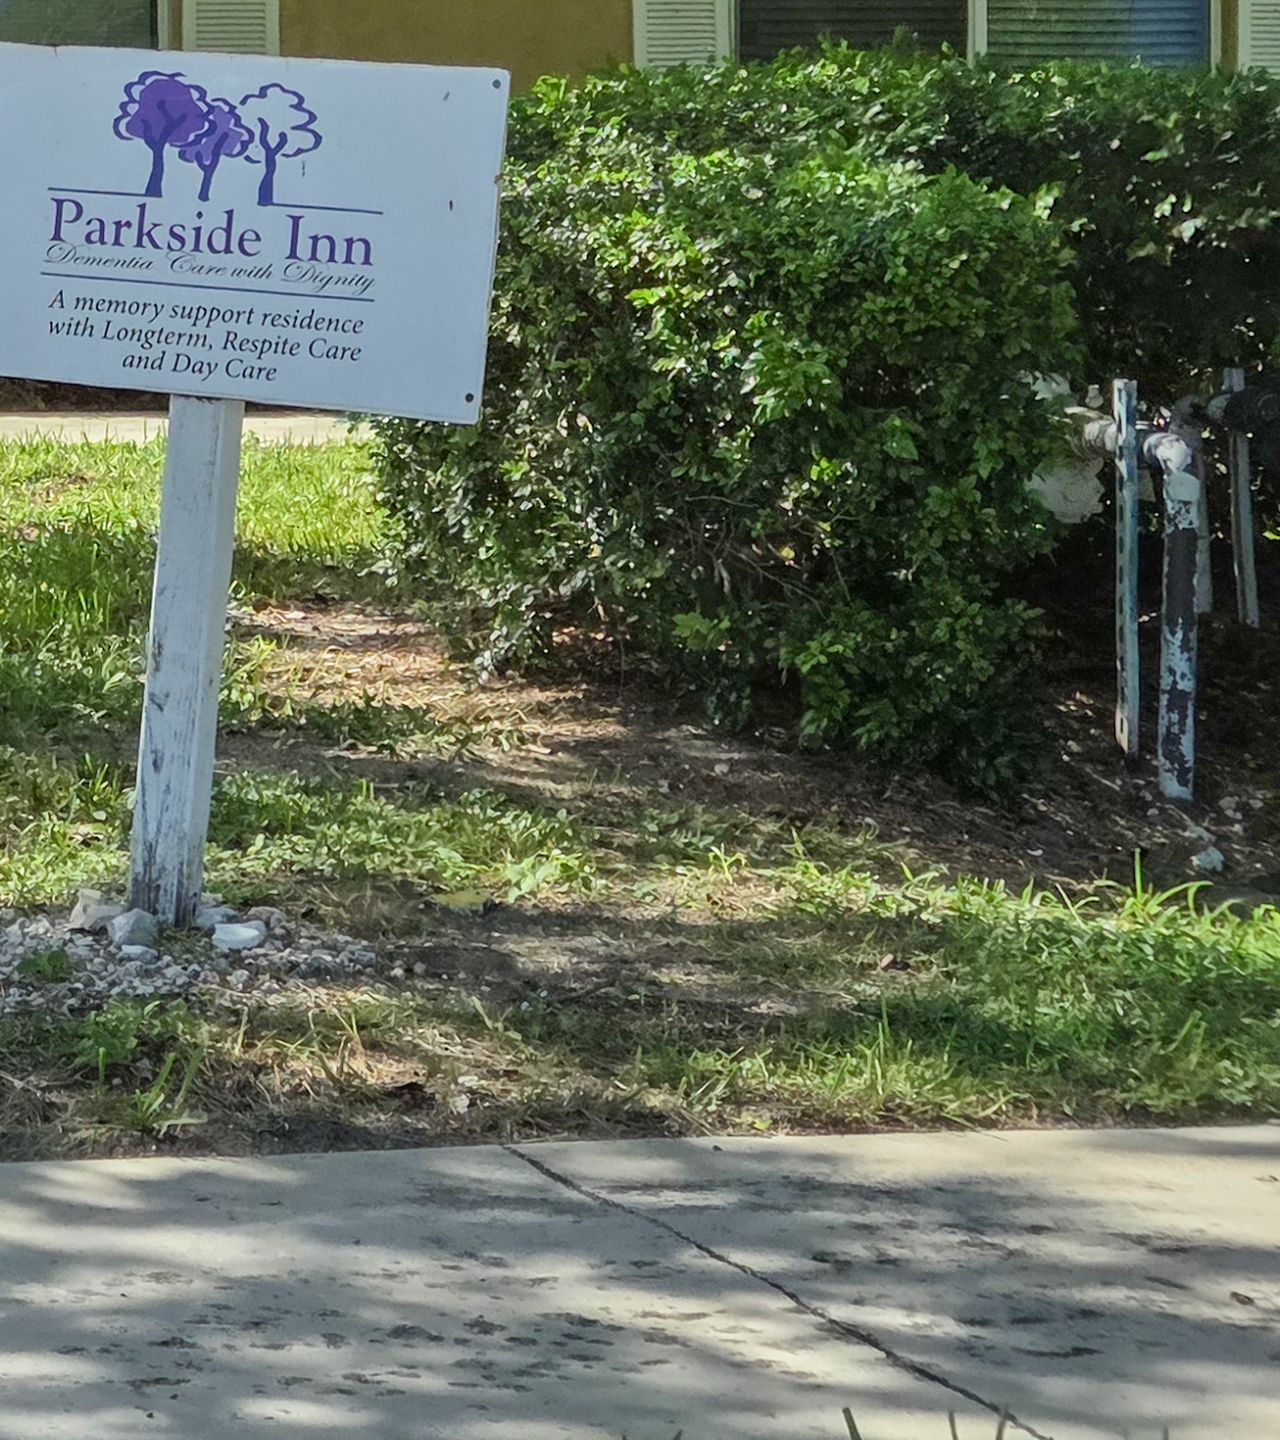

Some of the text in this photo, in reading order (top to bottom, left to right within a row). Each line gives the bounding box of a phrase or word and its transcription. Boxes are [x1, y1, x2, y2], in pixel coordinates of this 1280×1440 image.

[49, 197, 374, 266] Parkside Inn
[43, 242, 375, 296] Dementia Care with Dignity
[48, 289, 364, 335] A memory support residence
[49, 317, 362, 361] with Longterm, Respite Care
[122, 351, 277, 382] and Day Care
